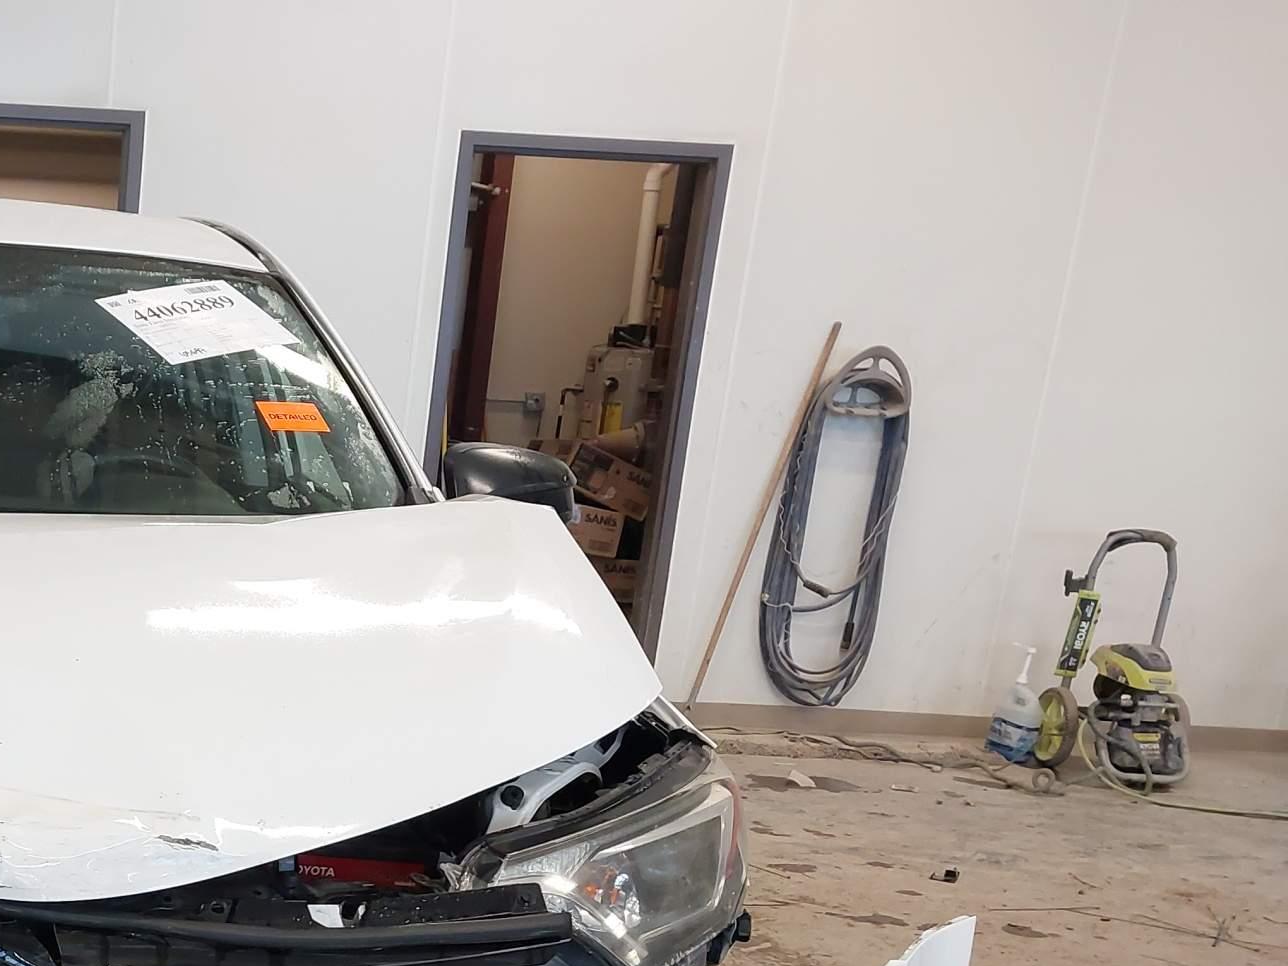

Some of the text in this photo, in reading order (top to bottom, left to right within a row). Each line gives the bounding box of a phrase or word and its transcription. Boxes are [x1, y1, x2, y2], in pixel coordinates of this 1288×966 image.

[133, 294, 235, 322] 44062889
[268, 413, 318, 421] DETAILED
[1073, 621, 1091, 650] RYOBI
